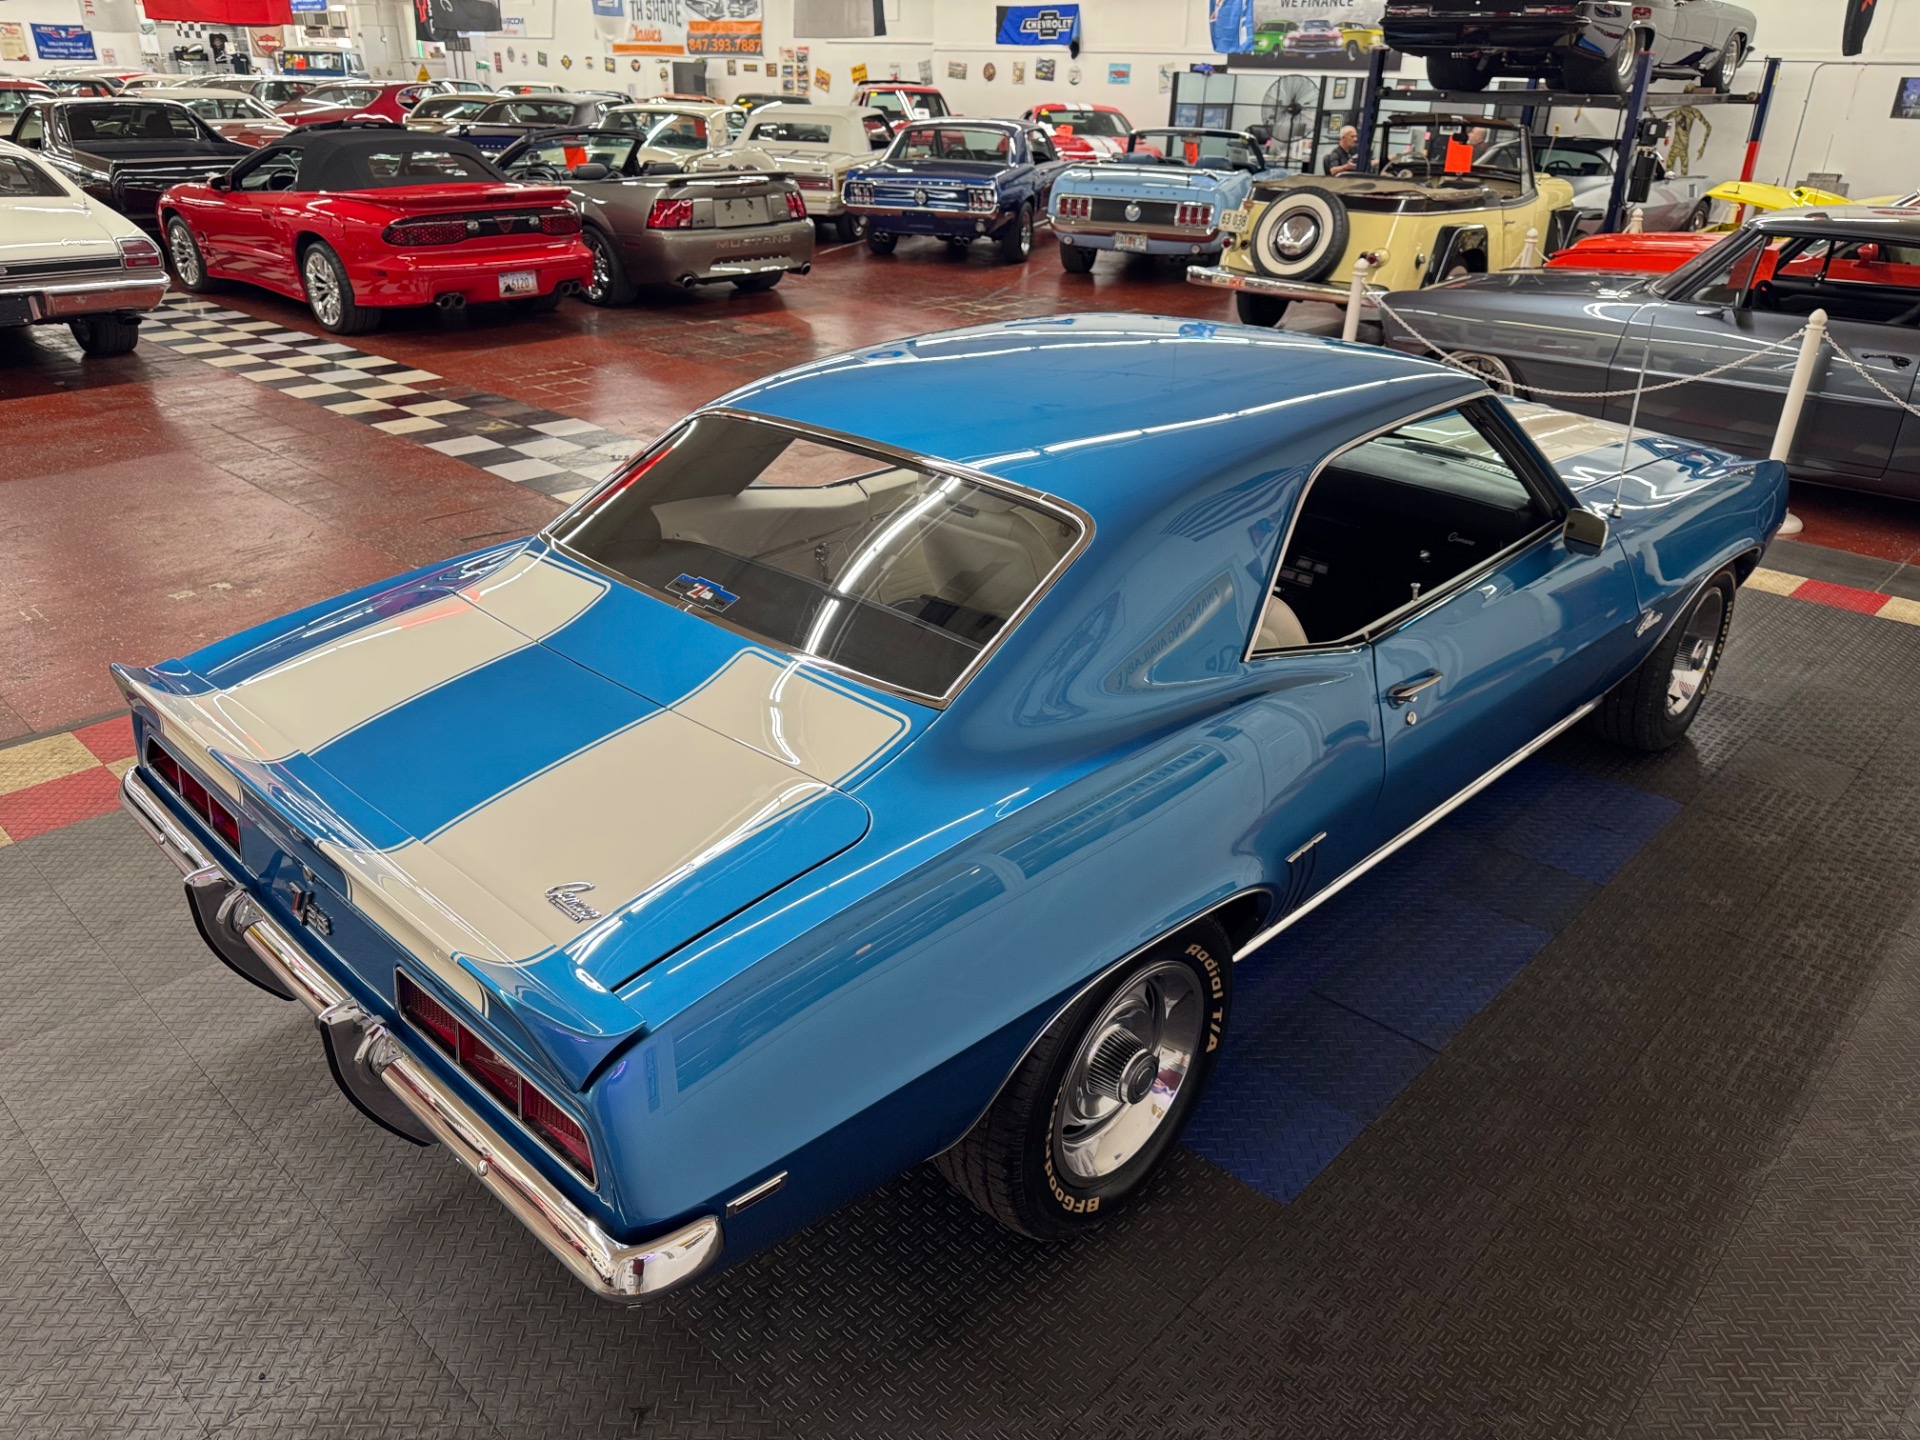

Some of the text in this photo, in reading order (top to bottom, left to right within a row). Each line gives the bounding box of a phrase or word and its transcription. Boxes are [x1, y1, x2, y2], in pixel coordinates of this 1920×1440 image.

[1281, 0, 1354, 8] WE FINANCE
[646, 0, 682, 28] SHORE
[1025, 19, 1074, 30] CHEVROLET
[688, 37, 762, 52] 847.393.7887
[716, 234, 792, 249] MUSTANG
[1184, 943, 1224, 1053] Radial T/A
